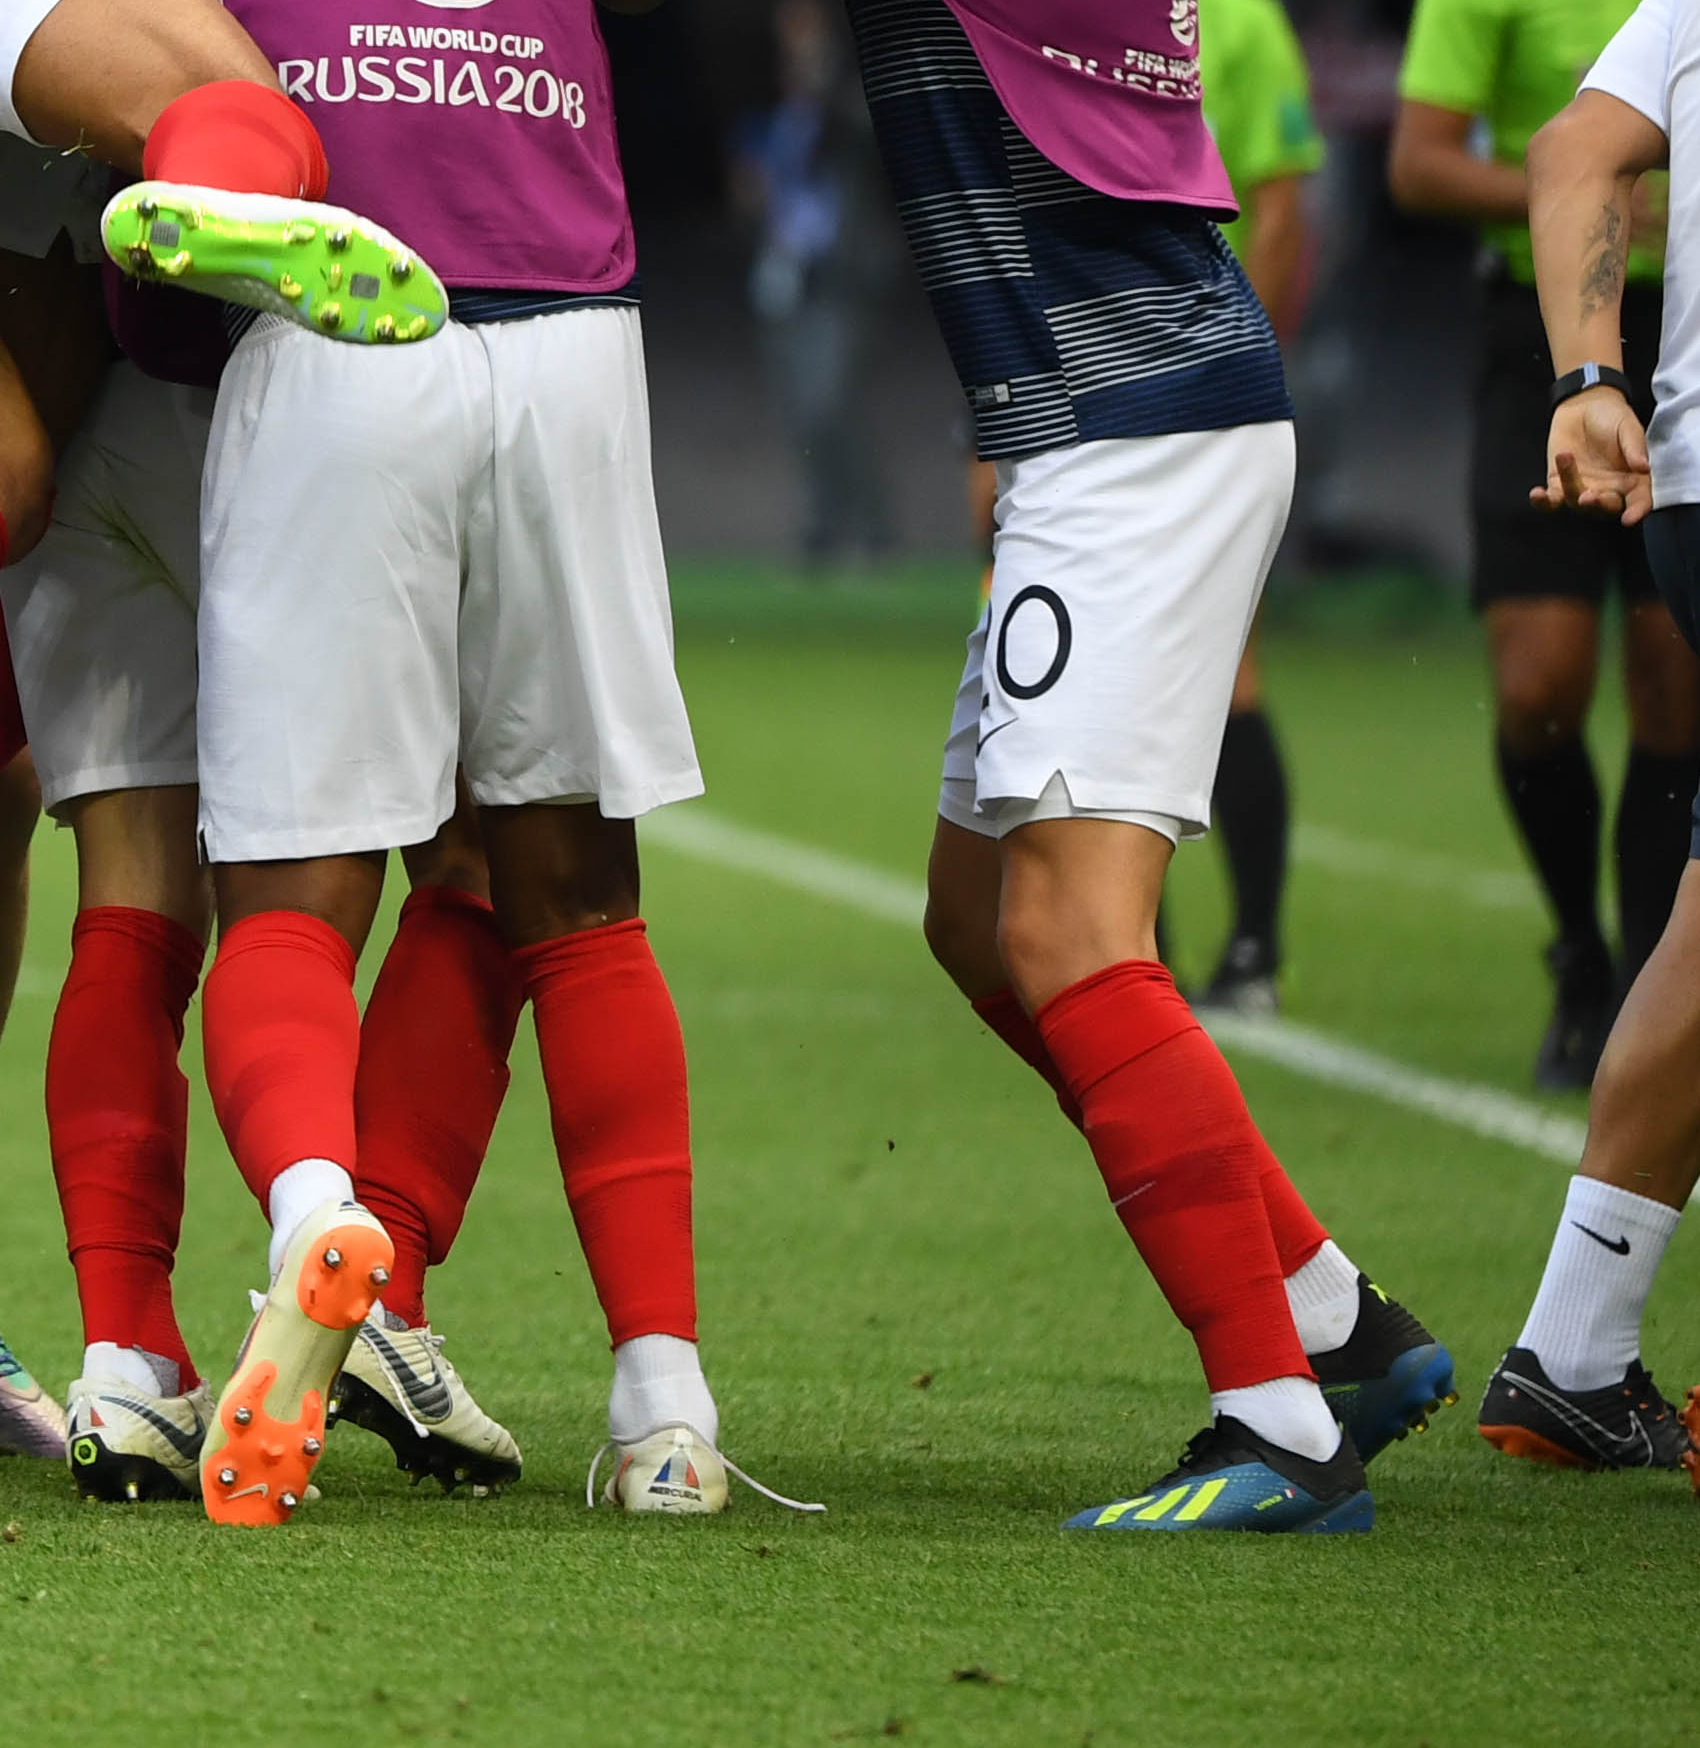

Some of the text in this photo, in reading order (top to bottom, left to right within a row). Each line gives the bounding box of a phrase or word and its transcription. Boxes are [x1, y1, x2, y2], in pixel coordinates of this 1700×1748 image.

[349, 25, 544, 59] FIFA WORLD CUP
[277, 56, 587, 129] RUSSIA 2018
